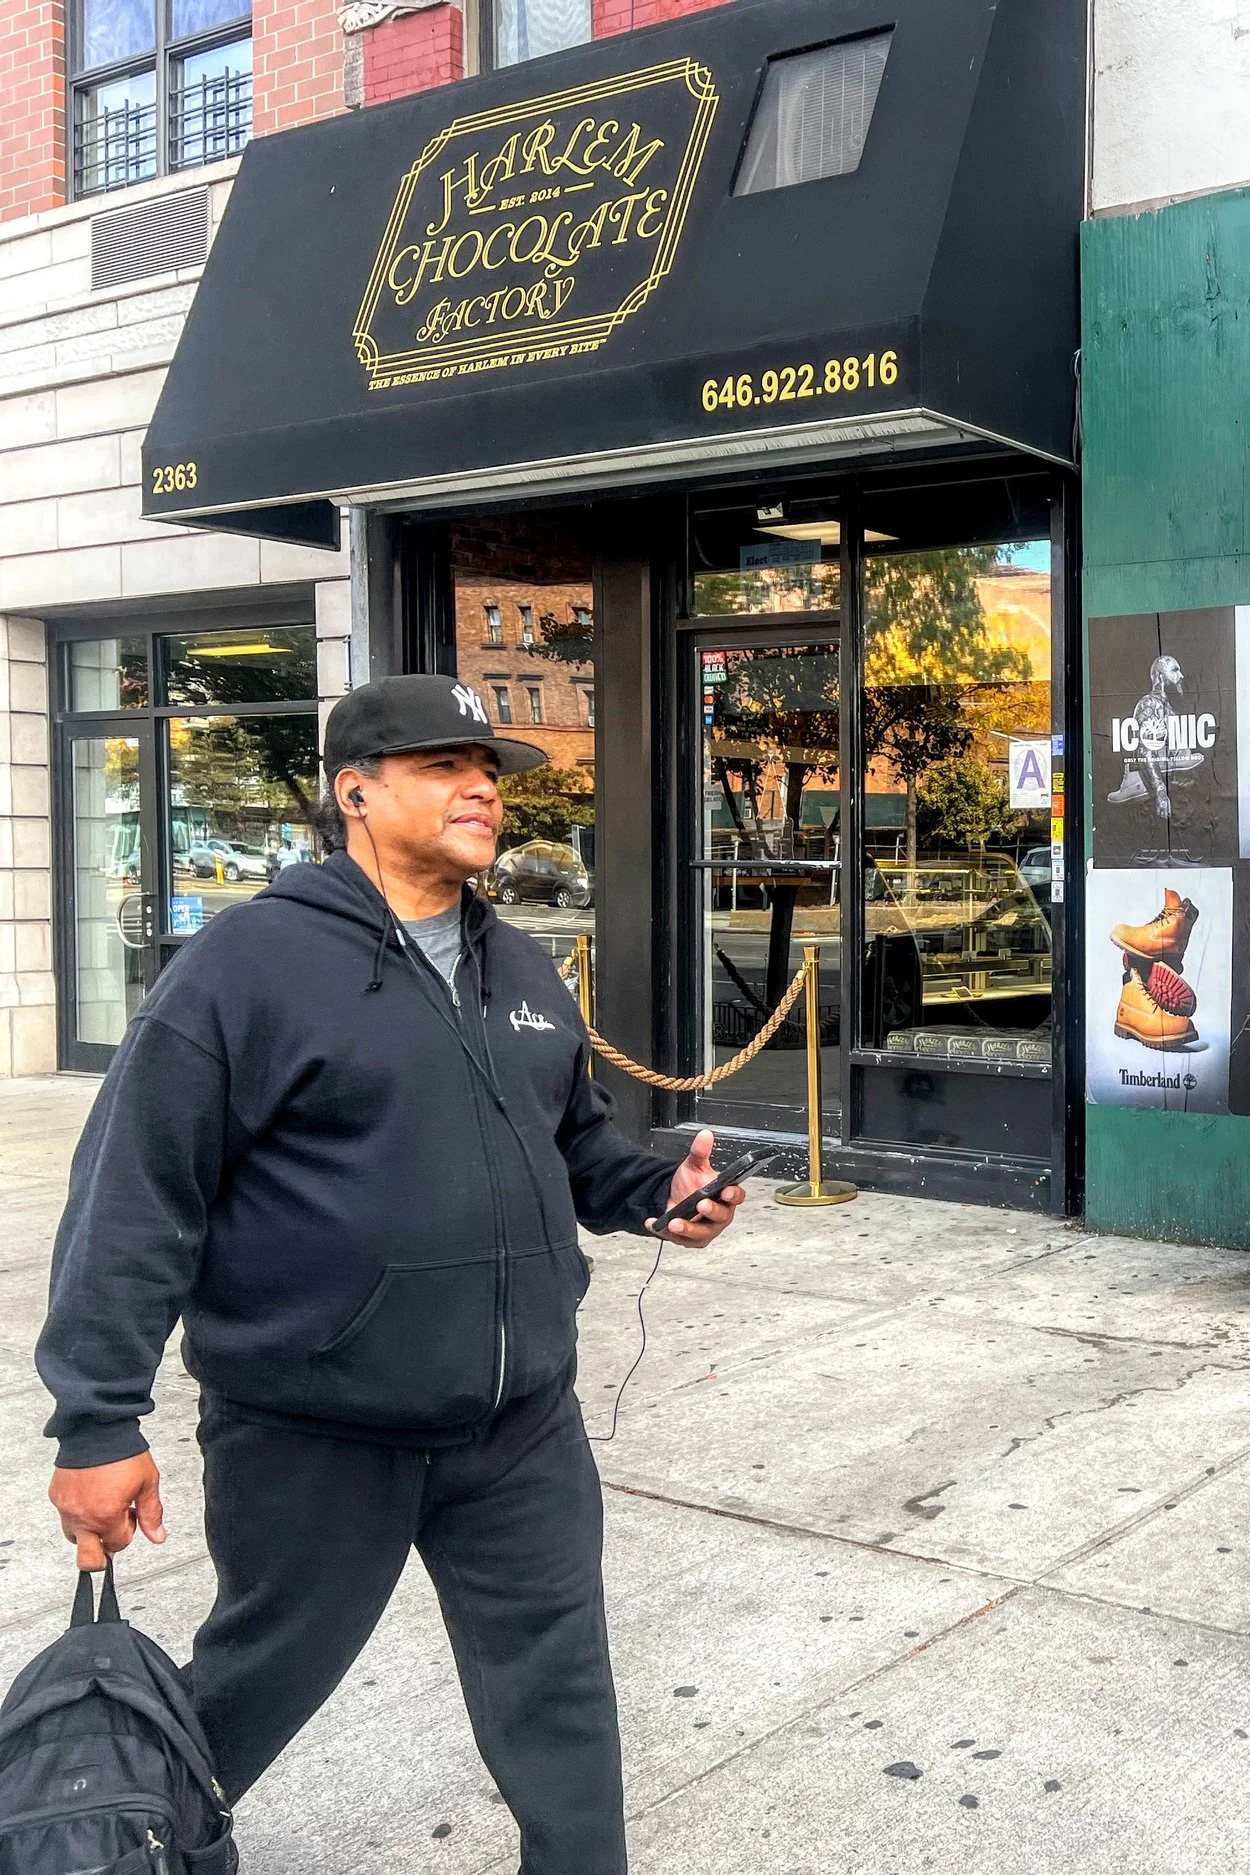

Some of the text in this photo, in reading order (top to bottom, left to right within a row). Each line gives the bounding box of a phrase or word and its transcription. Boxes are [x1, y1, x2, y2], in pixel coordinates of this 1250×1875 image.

[426, 118, 664, 235] HARLEM
[499, 187, 561, 211] EST. 2014
[388, 187, 667, 306] CHOCOLATE
[416, 276, 575, 344] FACTORY
[368, 378, 391, 391] THE
[391, 369, 440, 388] ESSENCE
[441, 365, 457, 378] OF
[457, 356, 508, 376] HARLEM
[509, 353, 526, 366] IN
[526, 345, 568, 364] EVERY
[702, 350, 898, 412] 646.922.8816
[152, 462, 198, 494] 2363
[746, 554, 768, 566] Elect
[451, 684, 488, 724] NY
[1017, 749, 1046, 789] A
[1119, 1069, 1181, 1089] Timberland
